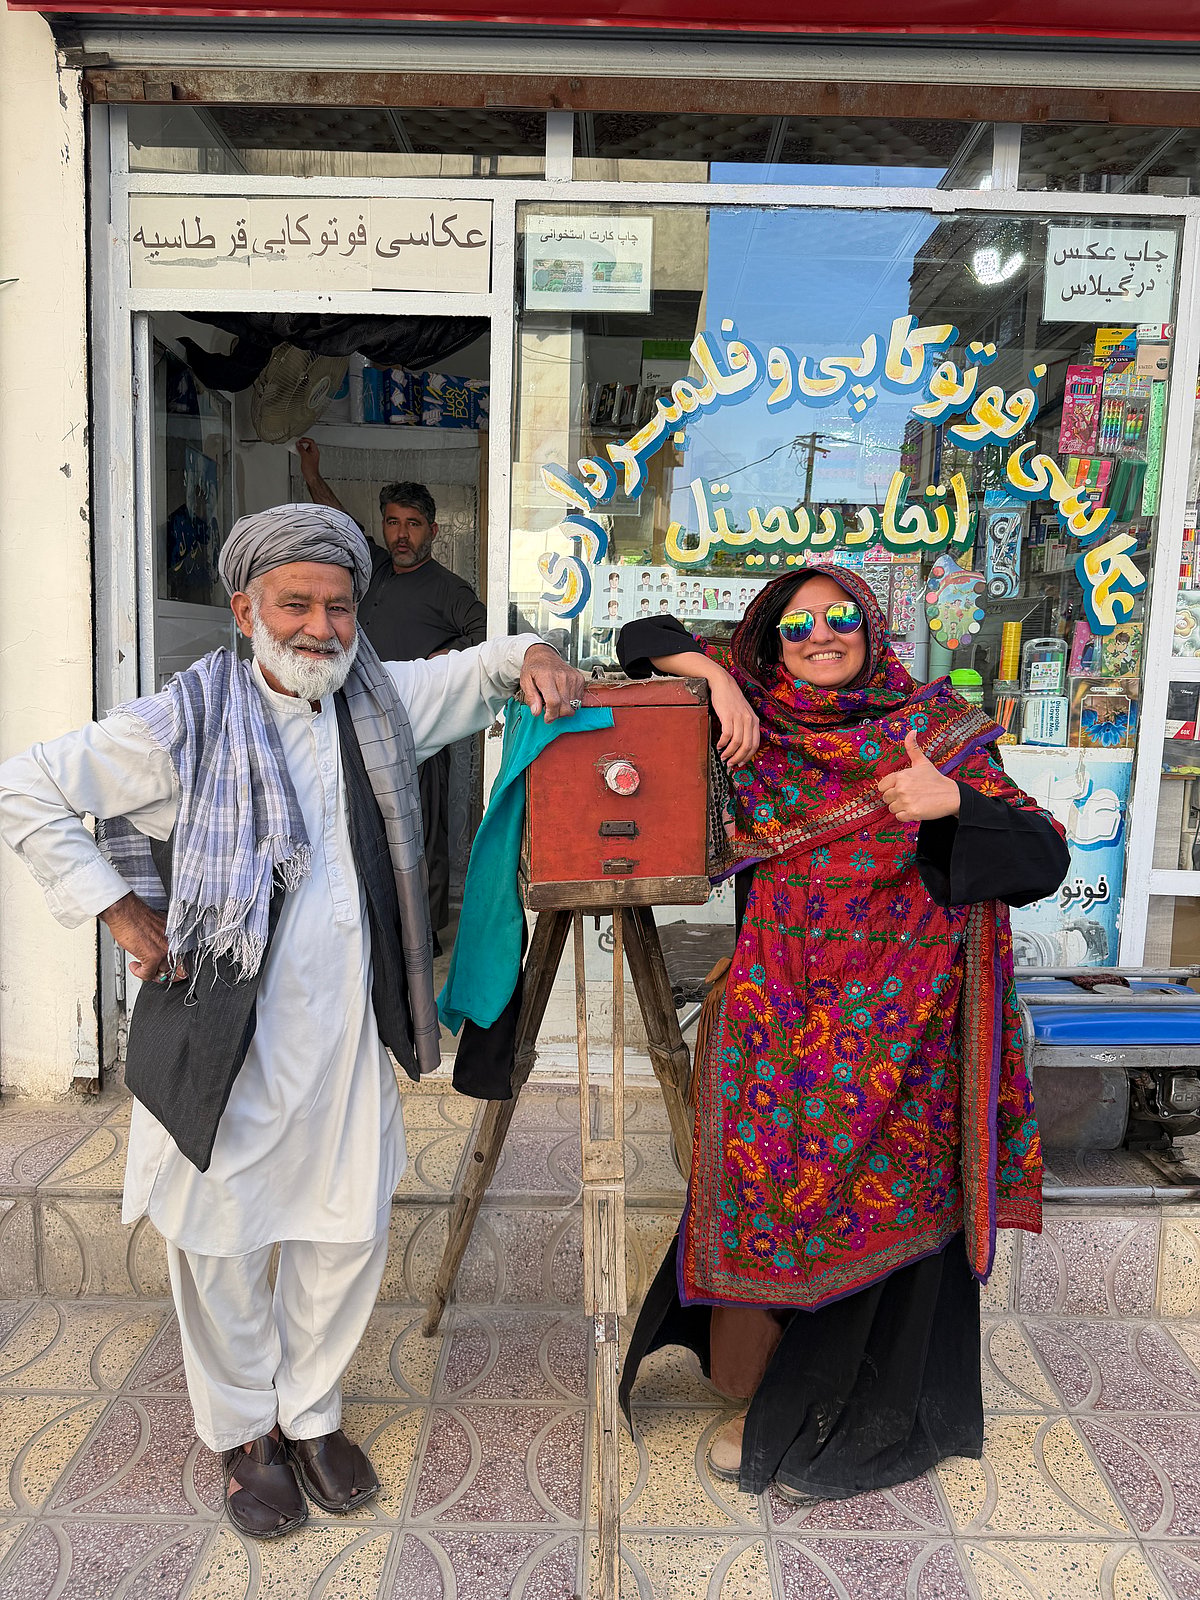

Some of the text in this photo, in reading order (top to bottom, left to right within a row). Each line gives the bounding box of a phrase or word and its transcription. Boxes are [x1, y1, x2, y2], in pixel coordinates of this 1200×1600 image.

[376, 212, 487, 259] عکاسی
[540, 228, 639, 246] چاپ کارت استخوانی
[1053, 239, 1169, 272] چاپ عکس
[1061, 273, 1134, 303] گیلاس
[844, 470, 970, 546] اتحاد
